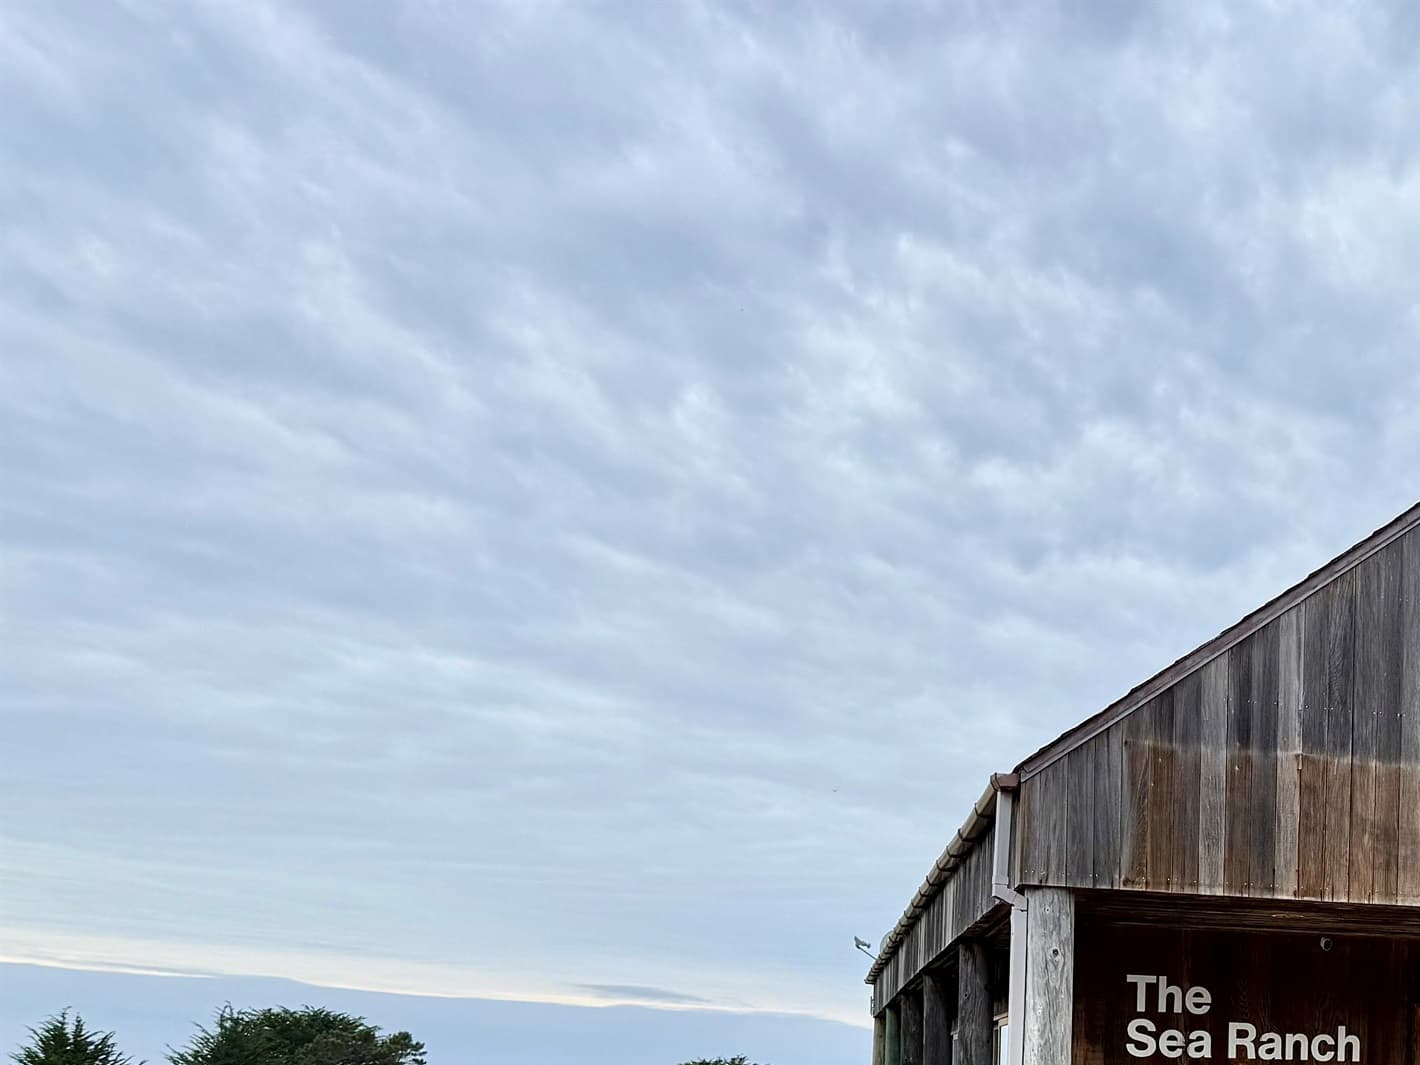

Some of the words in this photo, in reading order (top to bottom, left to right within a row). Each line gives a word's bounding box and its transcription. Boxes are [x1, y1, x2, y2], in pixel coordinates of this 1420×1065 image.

[1126, 974, 1212, 1015] The
[1126, 1018, 1212, 1059] Sea
[1227, 1021, 1360, 1062] Ranch
